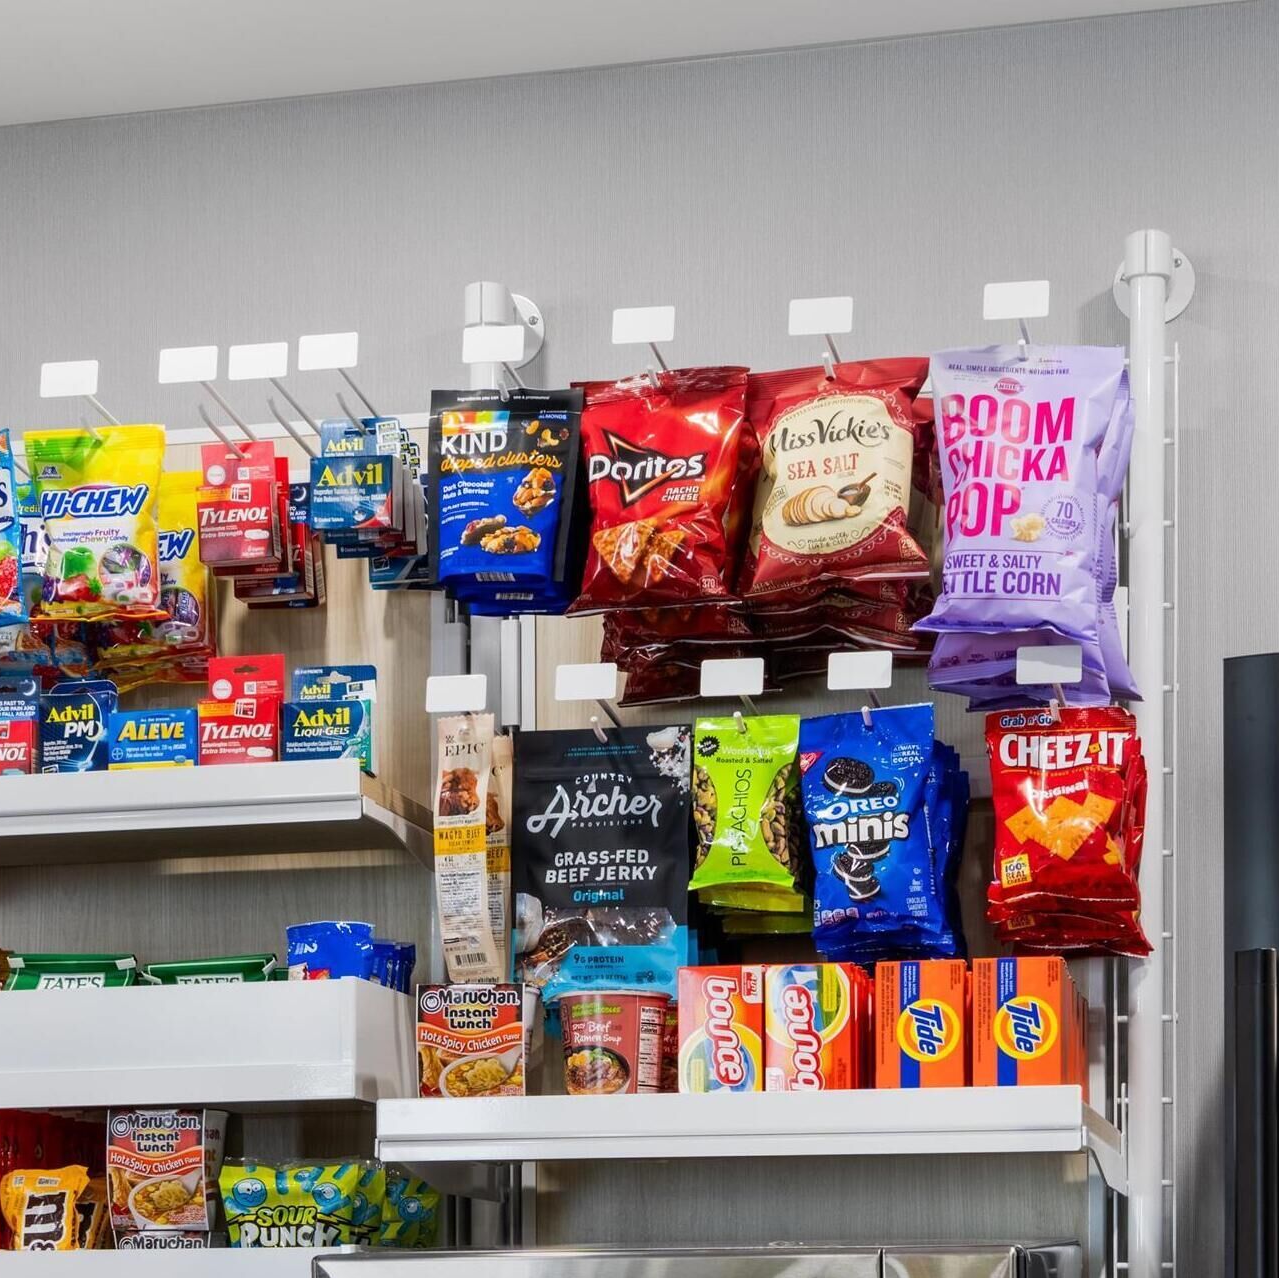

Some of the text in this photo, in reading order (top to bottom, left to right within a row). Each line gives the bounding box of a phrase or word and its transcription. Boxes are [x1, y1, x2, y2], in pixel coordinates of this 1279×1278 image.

[814, 410, 891, 448] Vickie's
[941, 393, 1076, 449] BOOM
[441, 431, 508, 455] KIND
[441, 450, 562, 473] dipped clusters
[588, 453, 707, 481] Doritos
[788, 453, 860, 481] SEA SALT
[948, 440, 1070, 489] CHICKA
[316, 463, 382, 486] Advil
[443, 480, 494, 493] Dark Chocolate
[40, 484, 148, 519] HI-CHEW
[665, 486, 700, 494] NACHO
[946, 482, 1022, 547] POP
[1056, 501, 1072, 520] 70
[943, 570, 1061, 596] ETTLE CORN
[64, 722, 95, 738] PM
[118, 721, 184, 742] ALEVE
[445, 742, 484, 758] EPIC
[999, 731, 1133, 770] CHEEZ-IT
[575, 772, 633, 786] COUNTRY
[527, 784, 663, 839] Archer
[731, 769, 752, 867] PISACHIOS
[817, 793, 899, 820] OREO
[813, 812, 909, 848] minis
[554, 849, 649, 868] GRASS-FED
[545, 866, 658, 884] BEEF JERKY
[573, 889, 625, 903] Original
[438, 989, 516, 1004] Maruchan
[444, 1007, 497, 1018] Instant
[450, 1019, 491, 1029] Lunch
[706, 976, 745, 1086] bounce
[909, 1004, 944, 1056] Tide
[256, 1206, 318, 1226] SOUR
[239, 1222, 340, 1248] PUNCH
